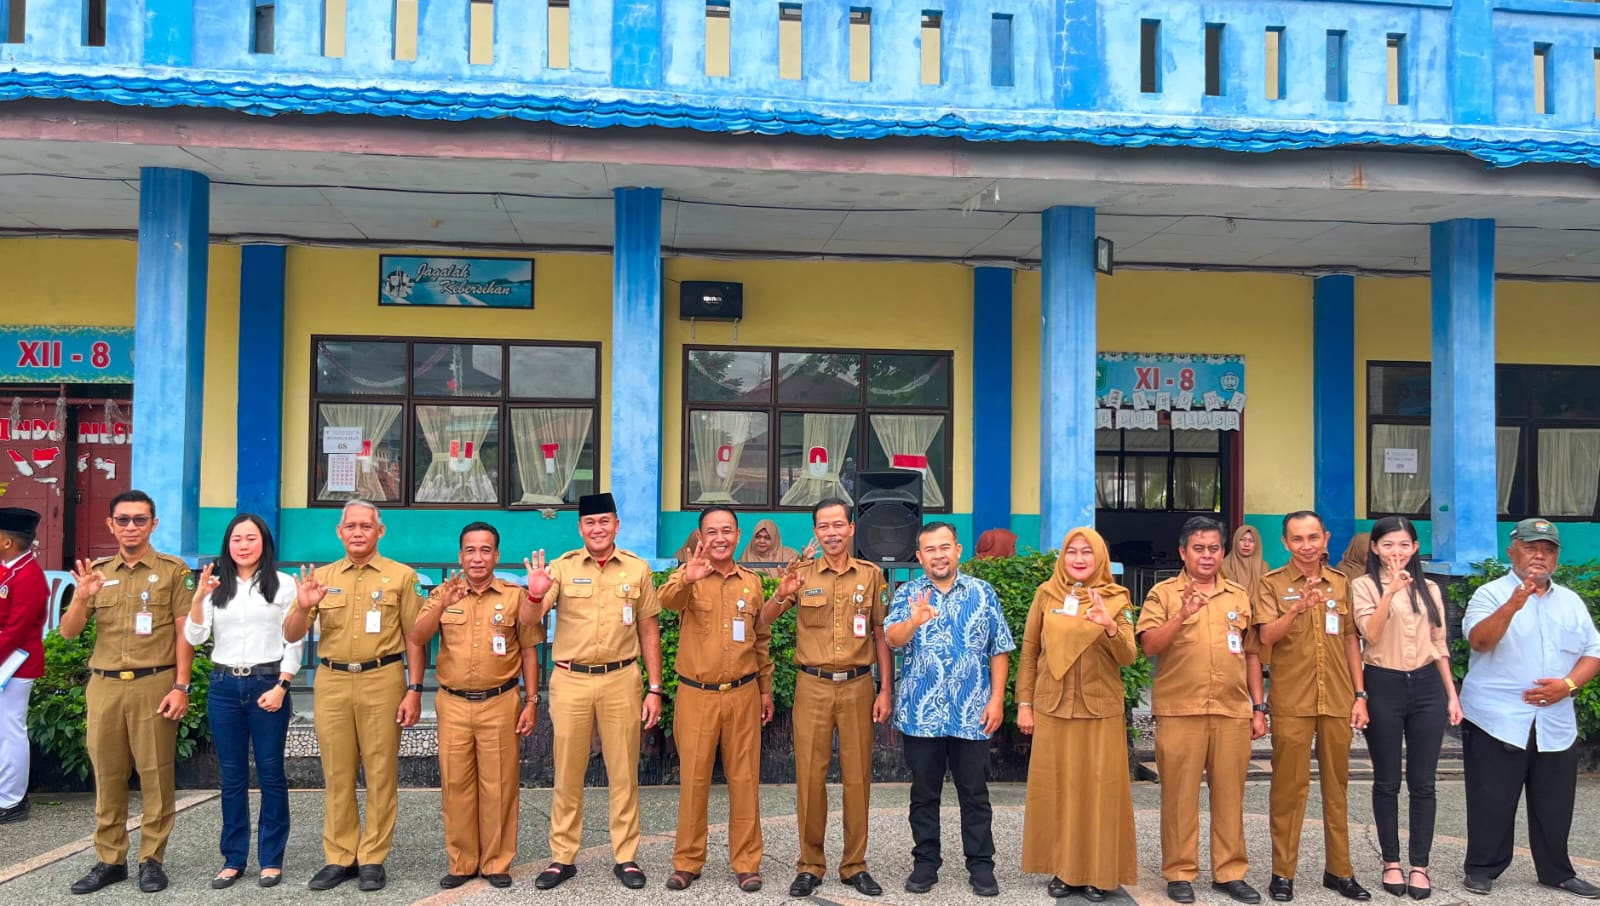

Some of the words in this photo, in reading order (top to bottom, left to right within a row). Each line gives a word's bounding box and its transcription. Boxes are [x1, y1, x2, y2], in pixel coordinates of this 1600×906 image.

[416, 262, 470, 282] Jagalah
[440, 280, 511, 295] Kebersihan
[17, 340, 62, 367] XII
[90, 341, 110, 368] 8
[1135, 367, 1160, 390] XI
[1179, 368, 1196, 391] 8
